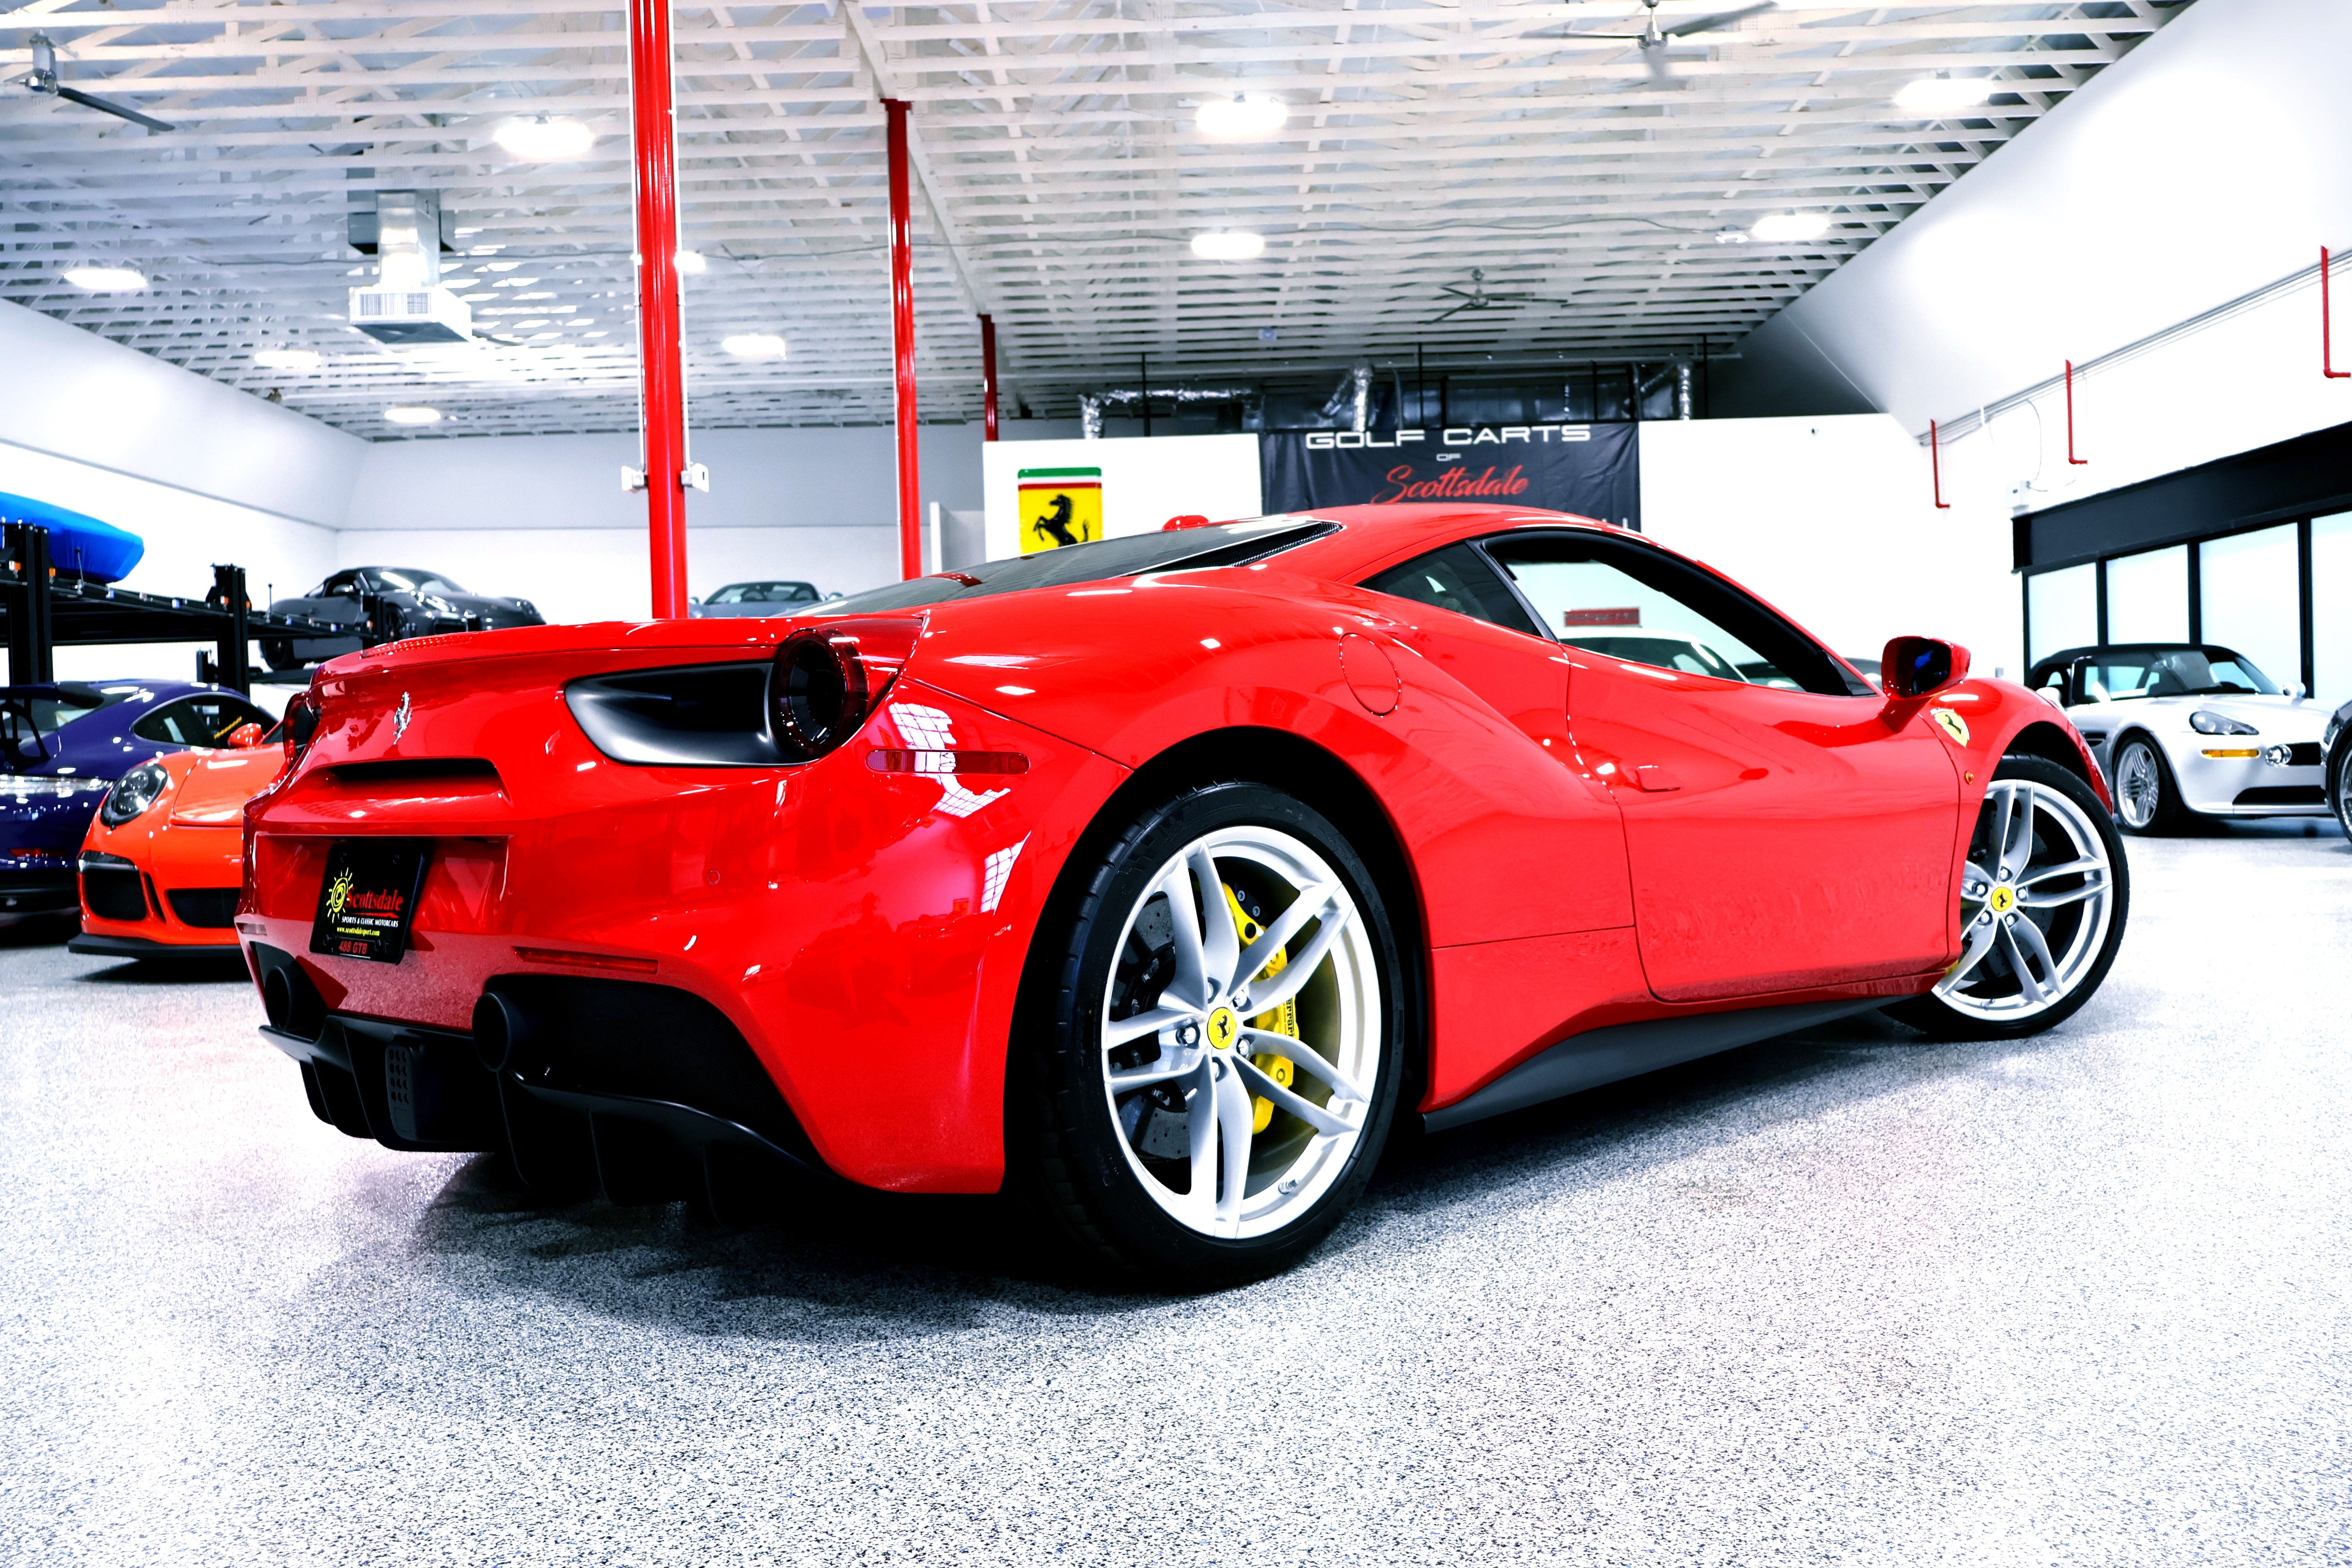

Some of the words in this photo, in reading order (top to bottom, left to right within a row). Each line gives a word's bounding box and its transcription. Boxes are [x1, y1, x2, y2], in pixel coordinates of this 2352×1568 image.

[1306, 429, 1425, 449] GOLF
[1443, 424, 1591, 445] CARTS
[1436, 453, 1461, 461] OF
[1370, 465, 1528, 504] Scottsdale
[344, 887, 403, 911] Scottsdale
[337, 927, 380, 936] www.scottsdalesport.com
[374, 919, 399, 927] MOTORCARS
[339, 940, 351, 952] 488
[353, 942, 368, 954] GTB
[1286, 998, 1294, 1037] errari
